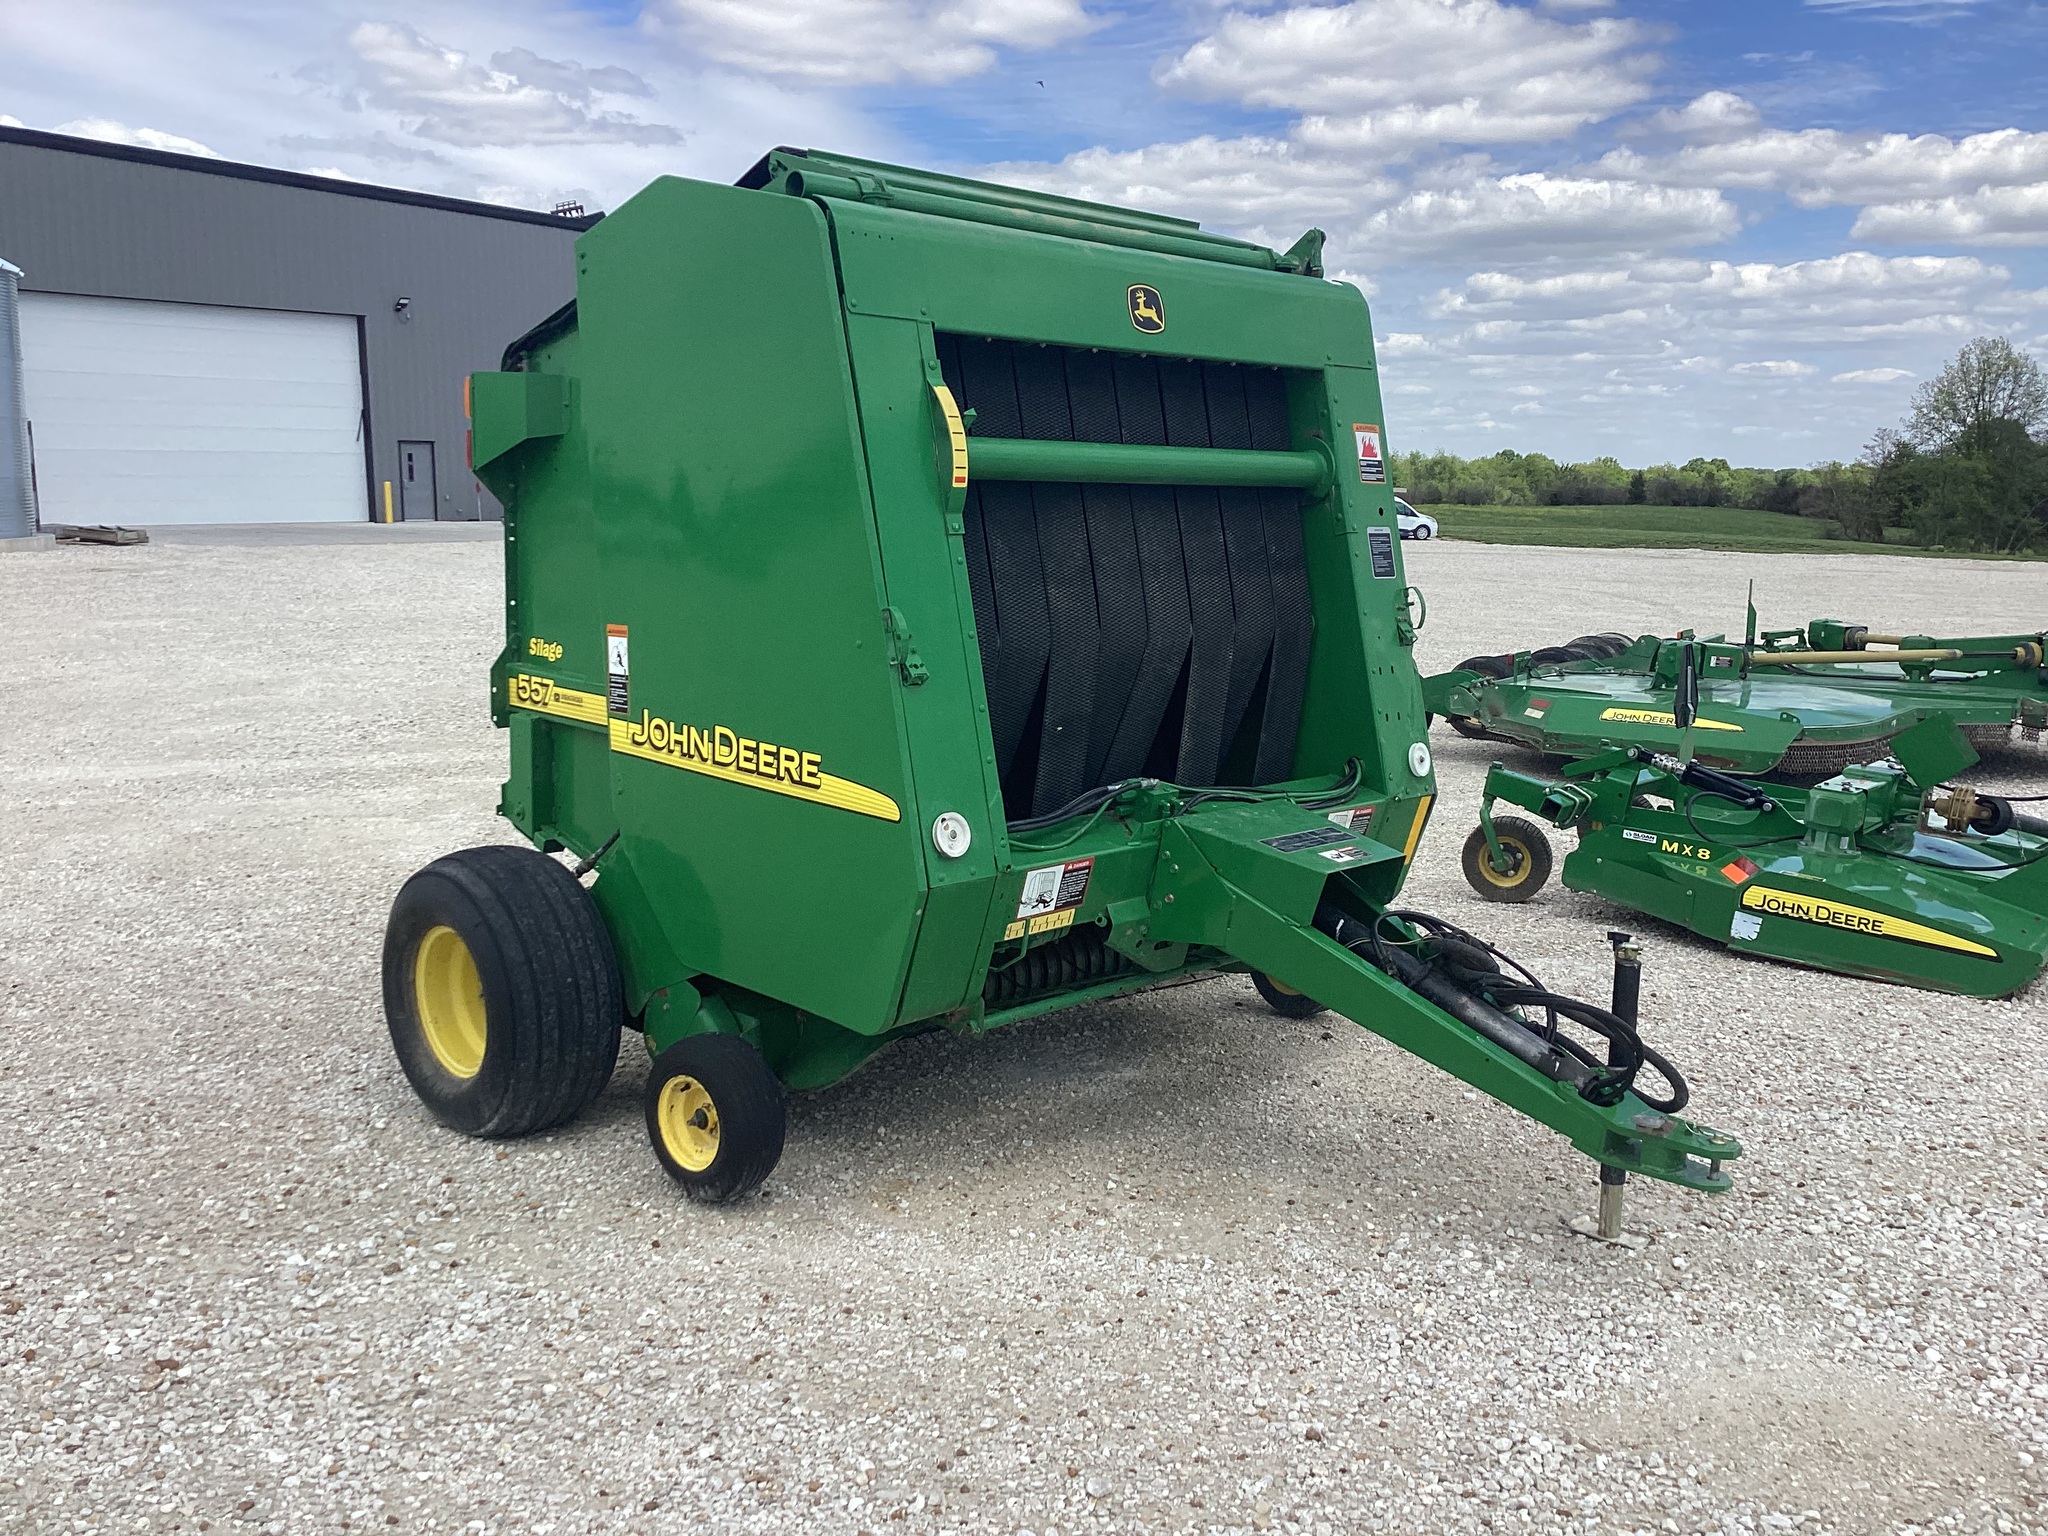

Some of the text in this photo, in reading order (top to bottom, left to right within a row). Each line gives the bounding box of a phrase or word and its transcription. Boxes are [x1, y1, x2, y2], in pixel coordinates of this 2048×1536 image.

[529, 637, 563, 662] Silage
[517, 673, 554, 706] 557
[1609, 711, 1675, 724] JOHN DEER
[632, 708, 822, 789] JOHN DEERE
[1661, 839, 1711, 860] MX8
[1754, 894, 1885, 933] JOHN DEERE
